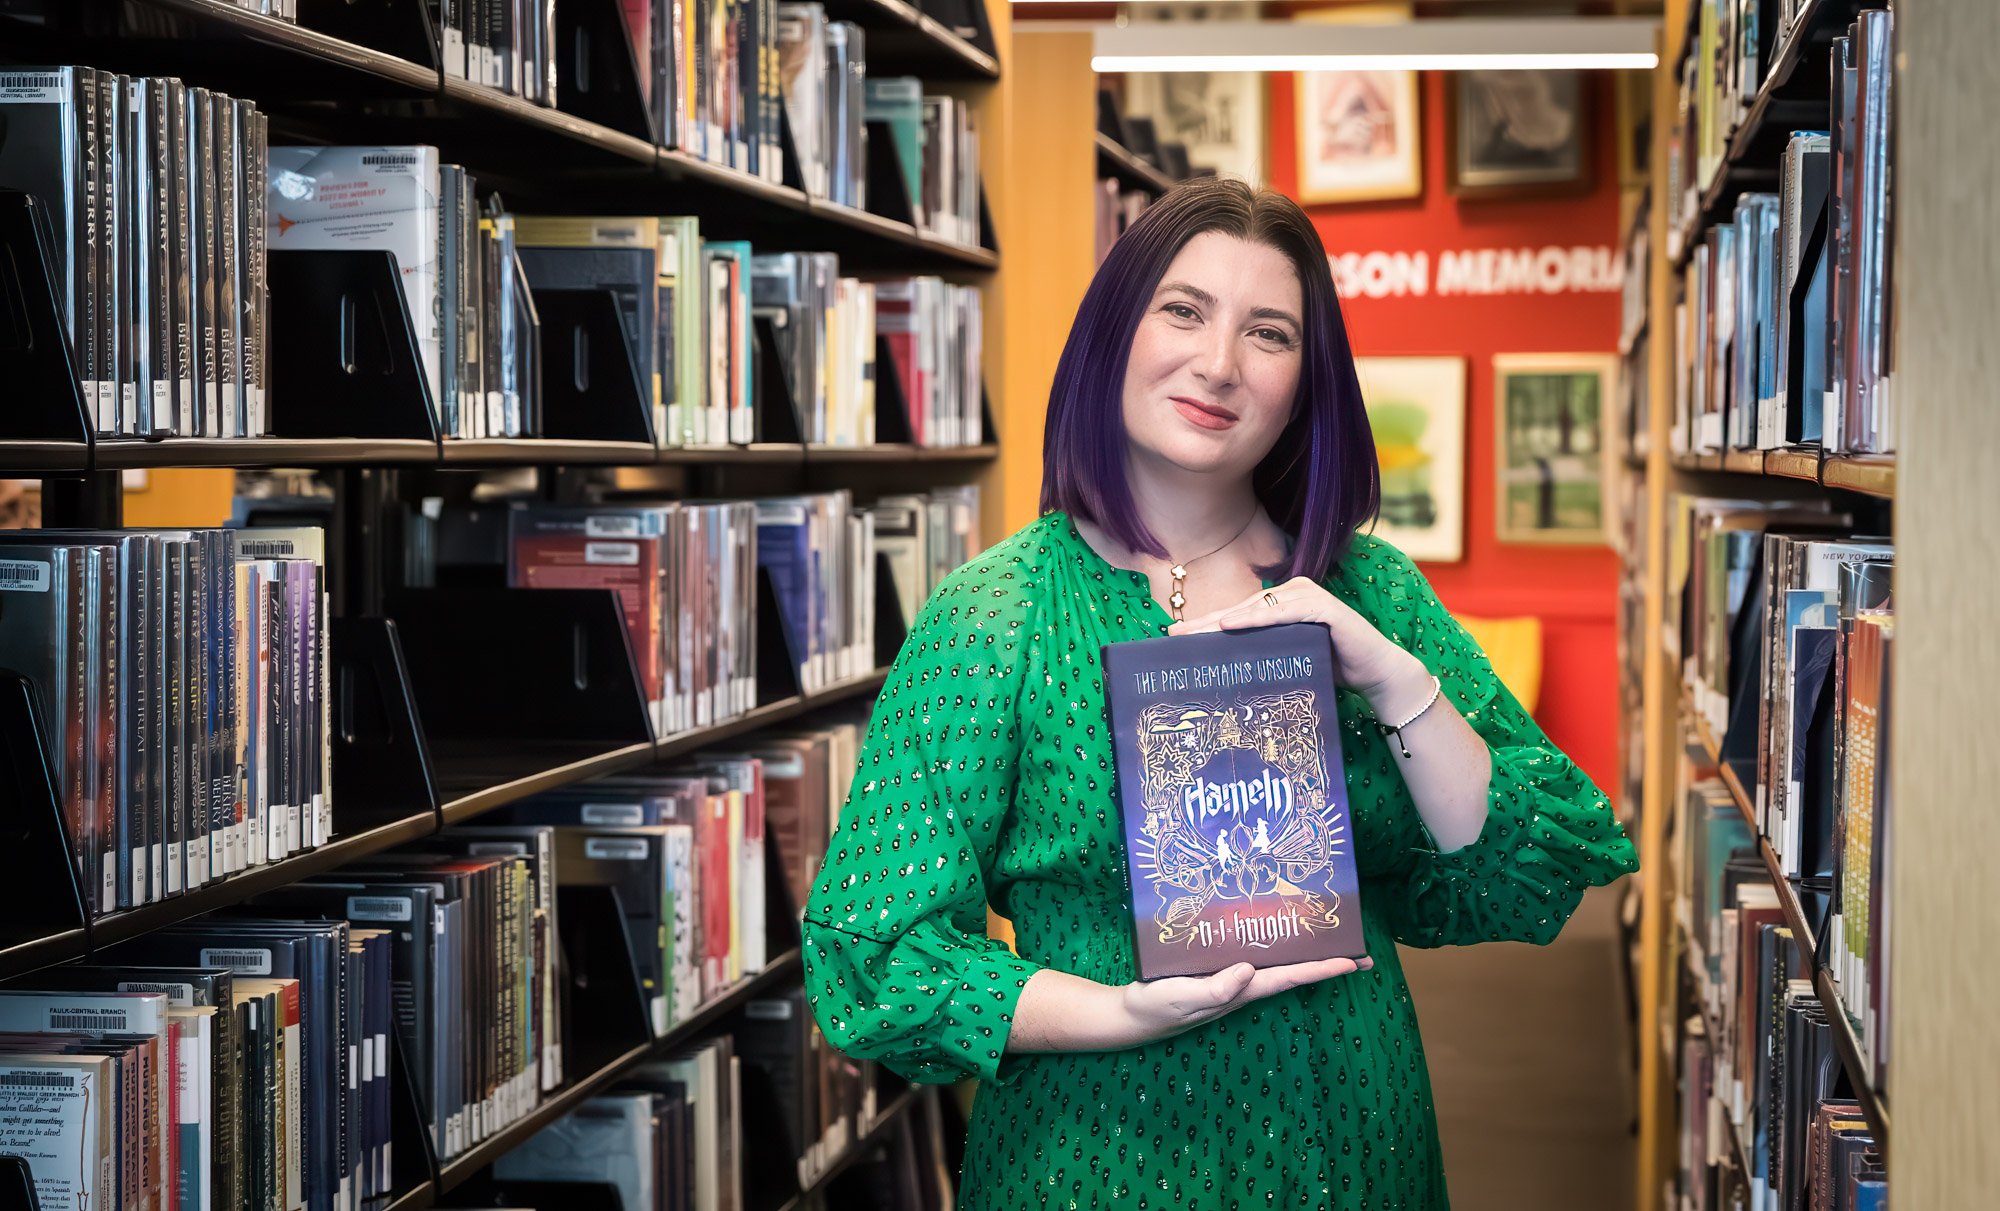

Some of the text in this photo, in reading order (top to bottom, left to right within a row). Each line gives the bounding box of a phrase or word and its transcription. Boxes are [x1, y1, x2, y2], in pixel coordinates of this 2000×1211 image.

[87, 105, 95, 249] STEVE BERRY
[160, 188, 168, 250] BERRY
[1436, 245, 1623, 296] MEMORIA
[178, 323, 189, 379] BERRY
[205, 327, 214, 382] BERRY
[222, 329, 231, 382] BERRY
[244, 337, 252, 380] BERRY
[308, 578, 316, 702] BEAUTYLAND
[1133, 656, 1313, 695] THE PAST REMAINS UNSUNG
[212, 778, 221, 825] BERRY
[222, 775, 232, 822] BERRY
[1184, 768, 1292, 829] Hameln
[49, 1007, 99, 1015] FAULK-CENTRAL
[35, 1116, 64, 1128] something
[142, 1056, 150, 1188] MUSTANG BEACH
[219, 1086, 231, 1165] STORIES
